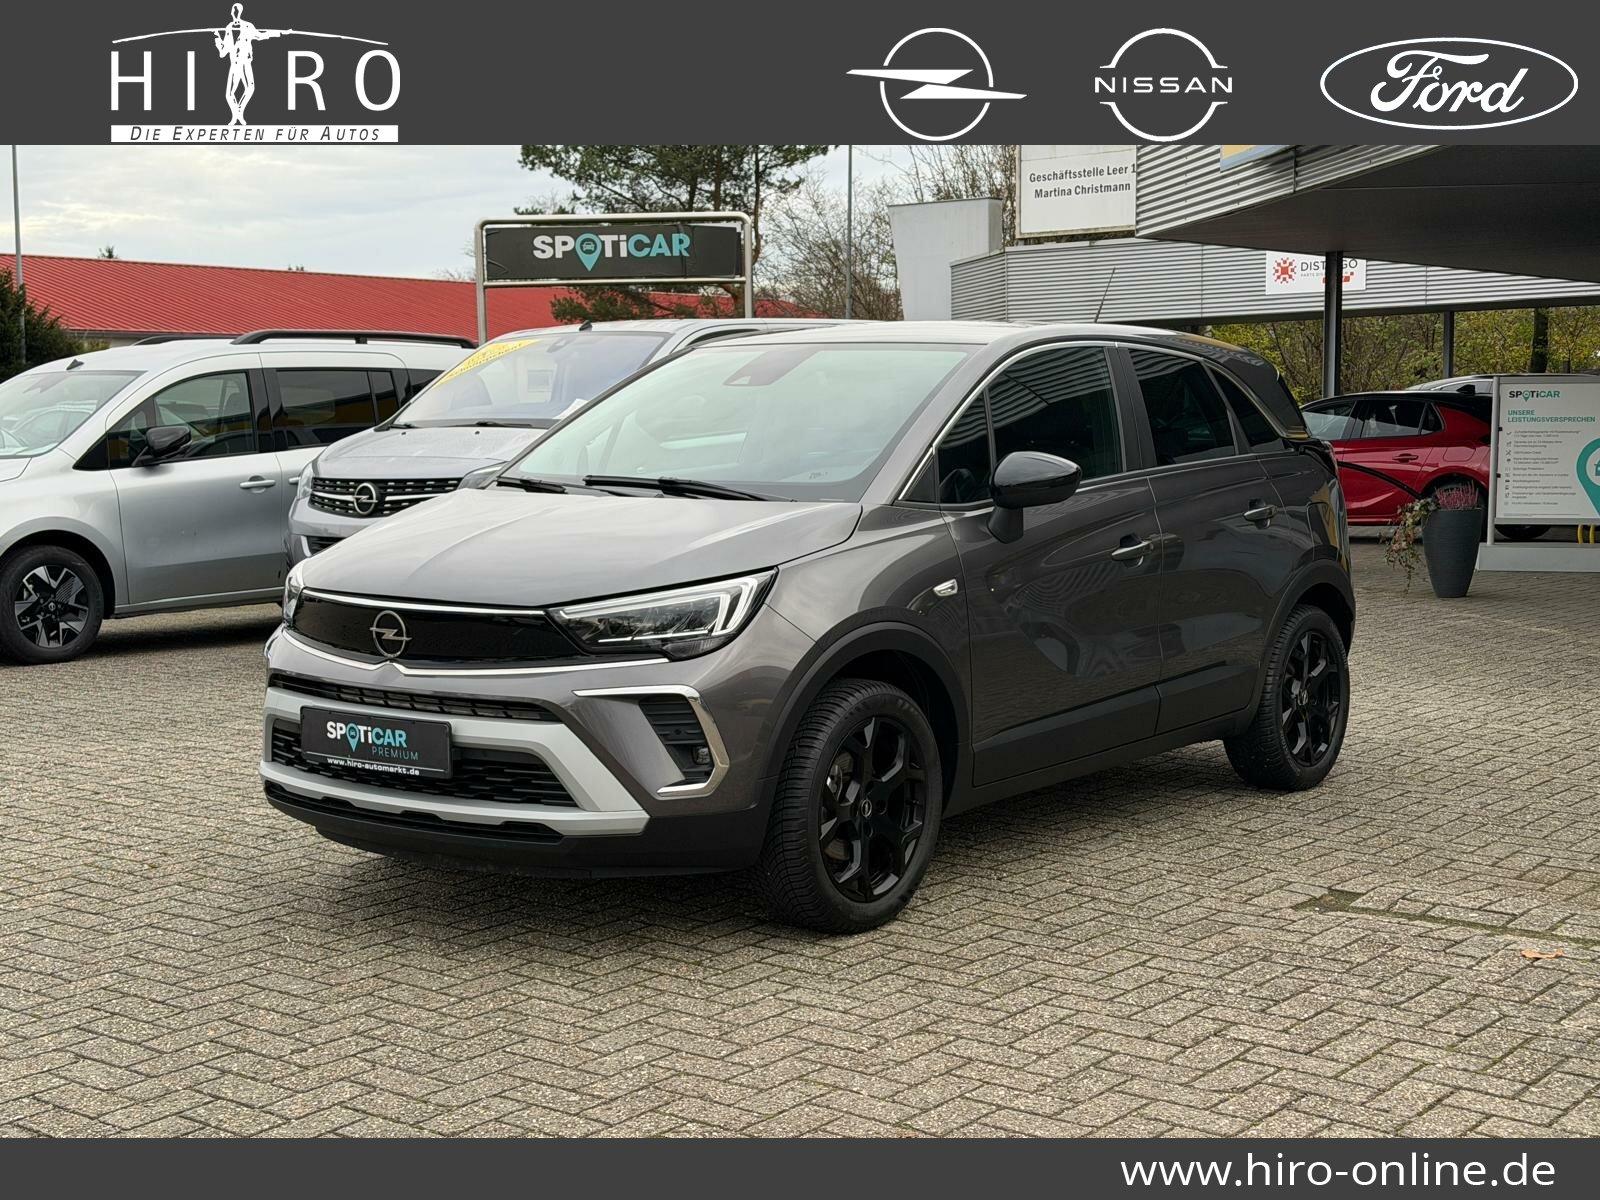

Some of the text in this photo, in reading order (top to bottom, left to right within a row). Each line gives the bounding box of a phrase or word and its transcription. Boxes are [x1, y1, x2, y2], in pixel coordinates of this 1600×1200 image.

[1029, 167, 1105, 183] Geschäftsstelle
[1106, 165, 1129, 176] Leer
[1034, 182, 1131, 199] Martina Christmann
[1300, 259, 1358, 272] DISTGO
[372, 745, 419, 760] PREMIUM
[326, 757, 420, 776] www.hiro-automarkt.de
